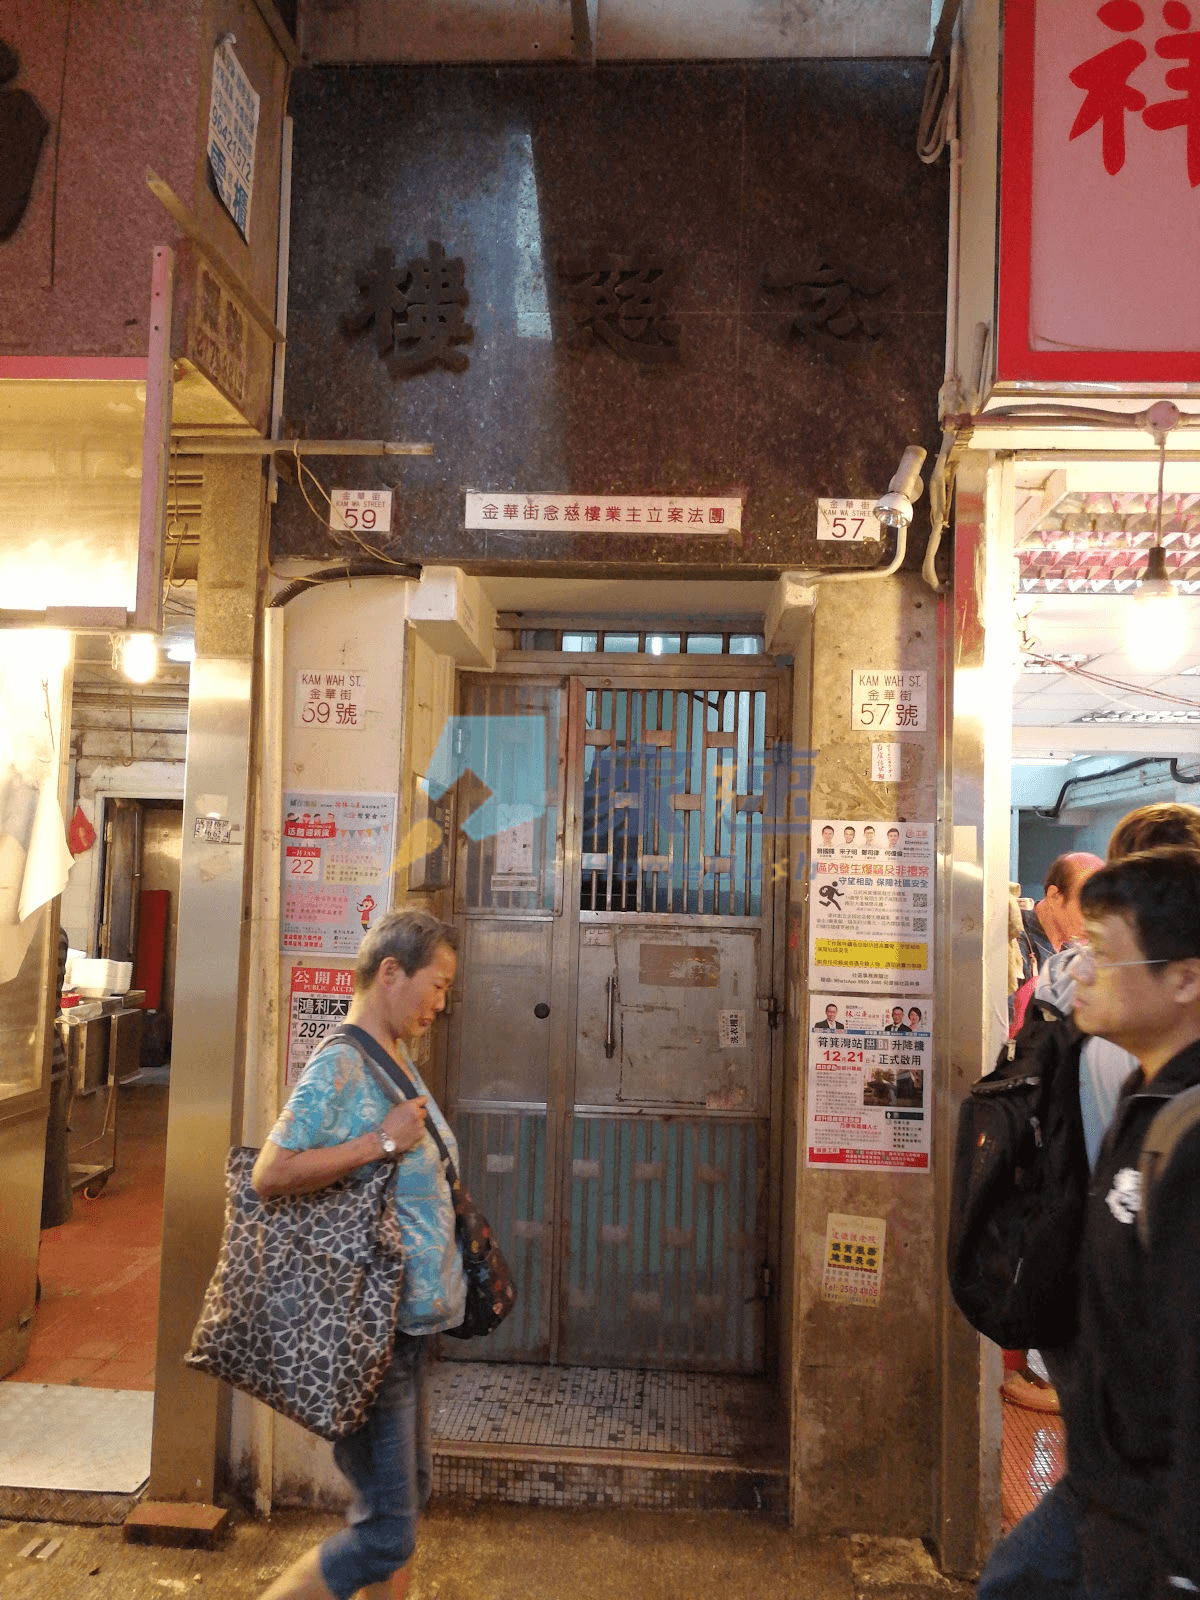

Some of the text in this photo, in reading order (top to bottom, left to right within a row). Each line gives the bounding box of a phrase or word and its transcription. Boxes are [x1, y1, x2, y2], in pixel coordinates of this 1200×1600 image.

[342, 491, 381, 500] 金華街
[829, 500, 870, 509] 金華街
[344, 508, 377, 529] 59
[481, 502, 726, 525] 金華街念慈樓業主立案法團
[831, 517, 865, 539] 57
[302, 674, 361, 687] KAM WAH ST.
[859, 674, 922, 687] KAM WAH ST.
[310, 688, 352, 700] 金華街
[868, 689, 912, 702] 金華街
[291, 859, 314, 875] 22
[839, 877, 929, 888] 守望相助 保障社區安全
[303, 984, 328, 992] PUBLIC
[299, 998, 354, 1016] 鴻利大
[818, 1036, 863, 1049] 筲箕灣站
[891, 1040, 925, 1051] 升降機
[878, 1054, 921, 1066] 正式啟用
[824, 1282, 838, 1291] Tel:
